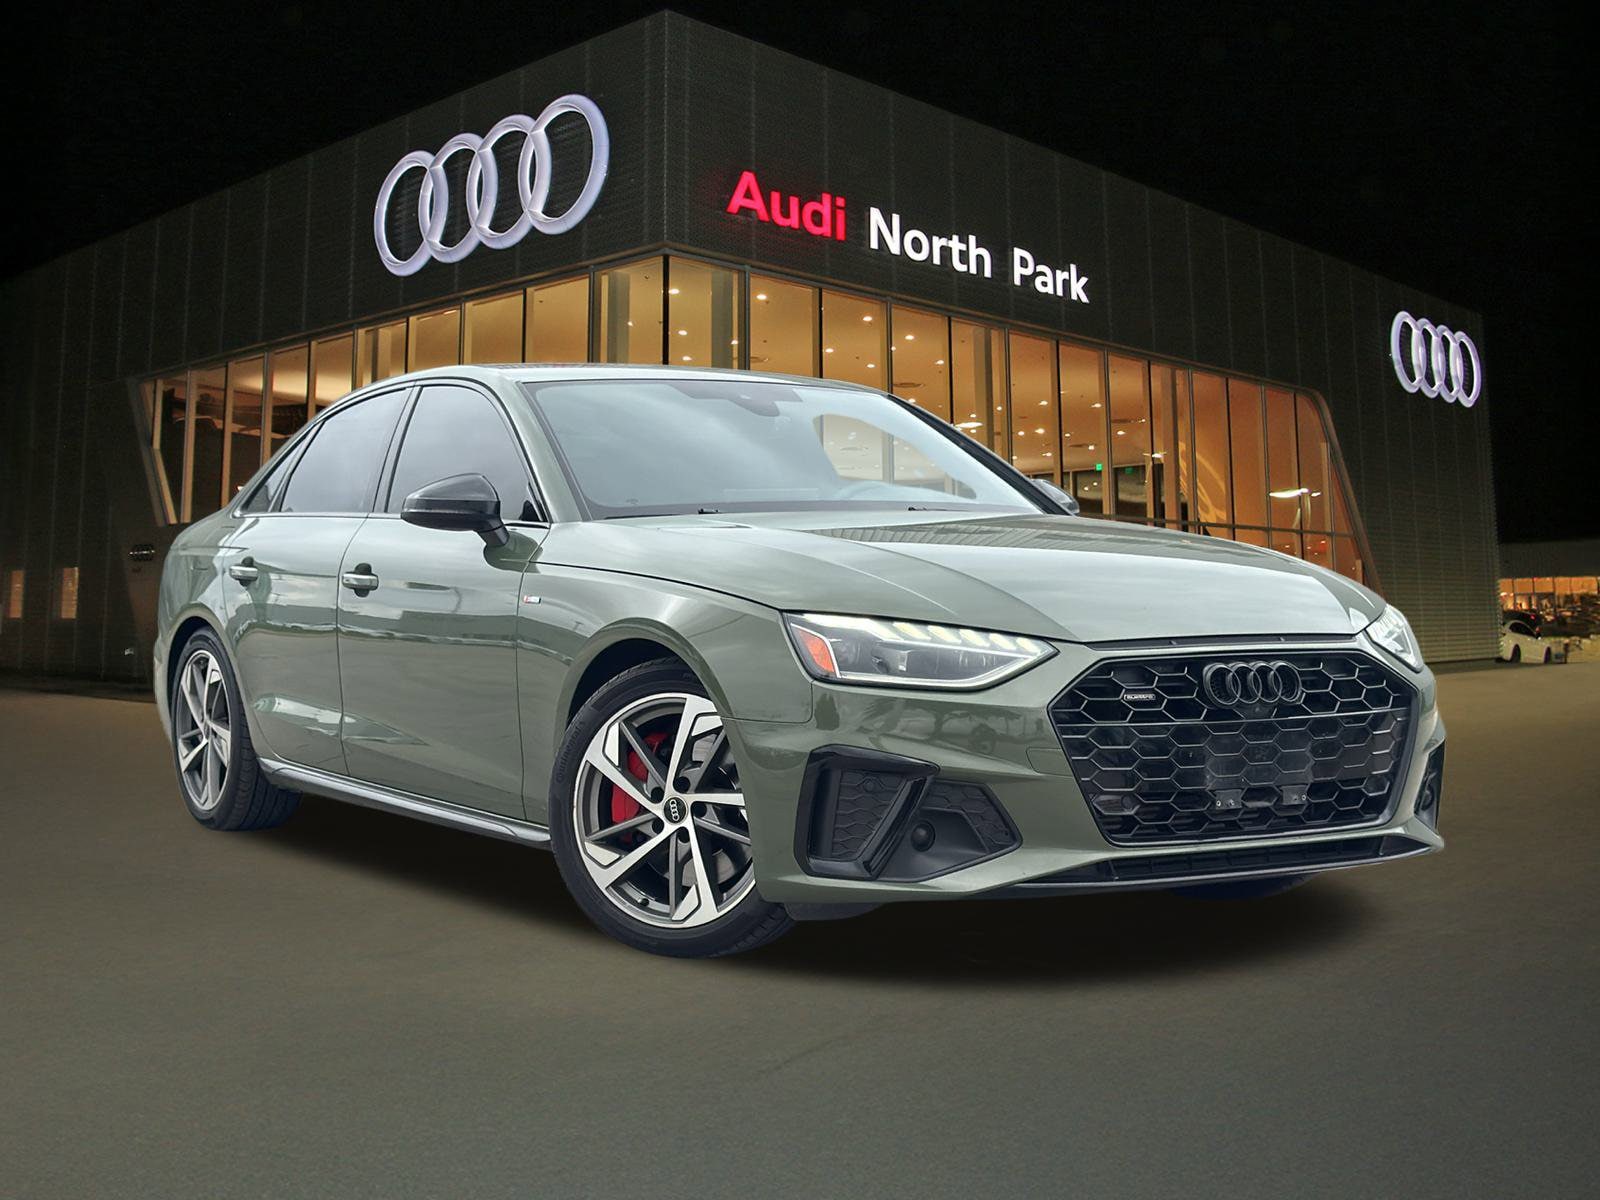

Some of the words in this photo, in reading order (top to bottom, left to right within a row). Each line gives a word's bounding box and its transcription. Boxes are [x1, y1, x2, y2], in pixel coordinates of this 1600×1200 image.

[726, 170, 847, 241] Audi
[868, 205, 992, 279] North
[1012, 246, 1091, 304] Park
